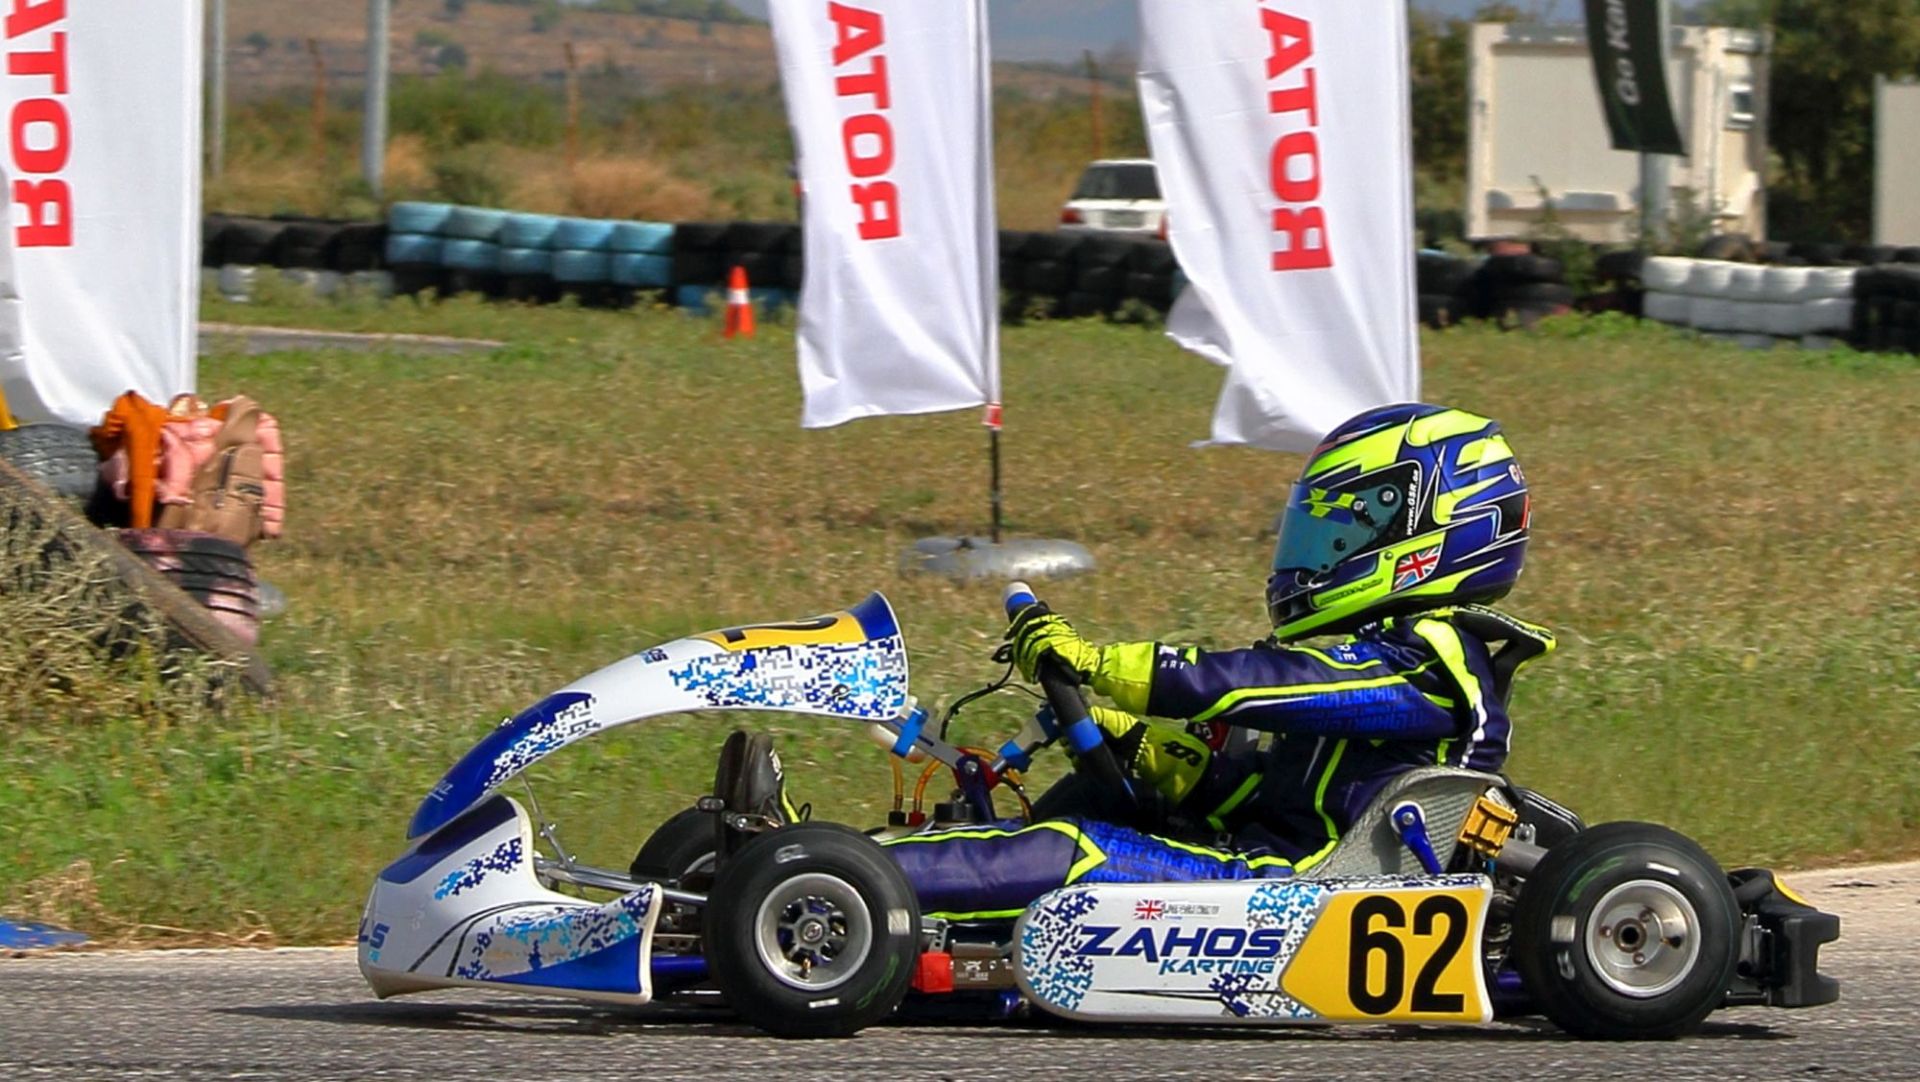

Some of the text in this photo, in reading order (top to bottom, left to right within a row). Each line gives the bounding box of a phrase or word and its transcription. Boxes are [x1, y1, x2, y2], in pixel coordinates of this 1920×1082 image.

[1076, 926, 1285, 962] ZAHOS
[1348, 895, 1468, 1015] 62
[1158, 959, 1276, 975] KARTING
